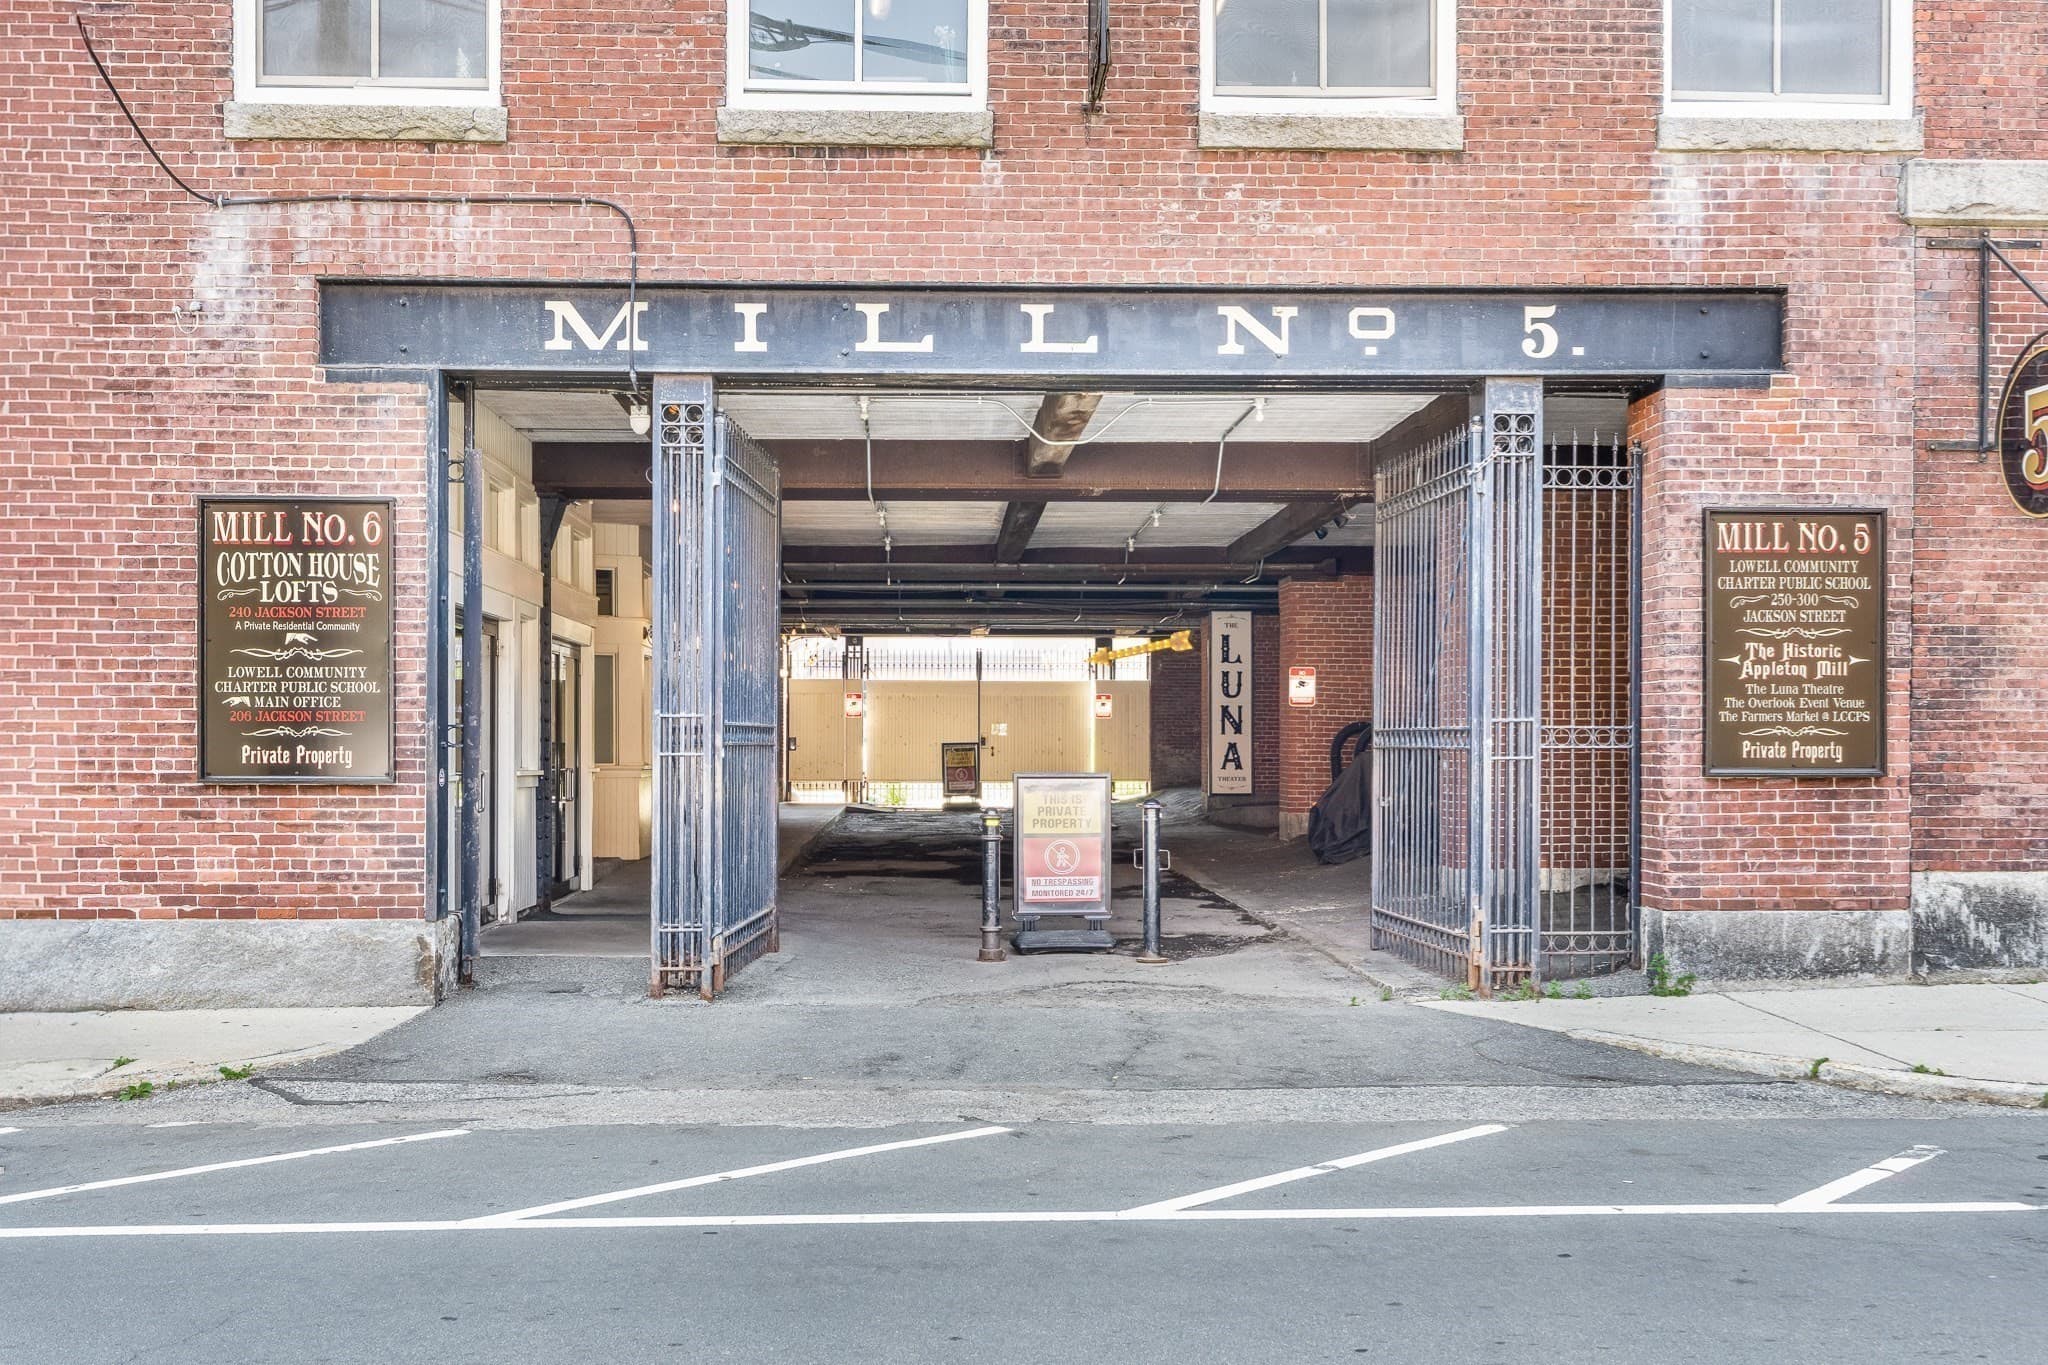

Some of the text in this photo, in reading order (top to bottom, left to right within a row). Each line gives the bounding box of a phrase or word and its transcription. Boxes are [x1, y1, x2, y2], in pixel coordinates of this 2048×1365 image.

[544, 301, 1098, 353] MILL
[212, 511, 383, 546] MILL NO. 6
[1716, 522, 1872, 555] MILL NO. 5
[216, 552, 381, 588] COTTON HOUSE
[1729, 560, 1860, 573] LOWELL COMMUNITY
[1717, 576, 1872, 590] CHARTER PUBLIC SCHOOL
[259, 580, 339, 605] LOFTS
[1770, 593, 1819, 606] 250-300
[228, 606, 367, 618] 240 JACKSON STREET
[1743, 609, 1847, 622] JACKSON STREET
[235, 621, 360, 633] A Private Residential Community
[1744, 642, 1843, 662] The Historic
[227, 666, 368, 679] LOWELL COMMUNITY
[1738, 660, 1849, 680] Appleton Mill
[214, 681, 381, 694] CHARTER PUBLIC SCHOOL
[1745, 683, 1845, 695] The Luna Theatre
[254, 696, 341, 708] MAIN OFFICE
[1220, 634, 1243, 770] LUNA
[1724, 697, 1865, 709] The Overlook Event Venue
[255, 710, 312, 722] JACKSON
[315, 710, 367, 722] STREET
[1719, 711, 1871, 723] The Farmers Market @ LCCPS
[241, 745, 352, 768] Private Property
[1742, 740, 1843, 763] Private Property
[1043, 794, 1068, 805] THIS
[1037, 806, 1087, 816] PRIVATE
[1032, 818, 1093, 829] PROPERTY
[1031, 878, 1094, 886] NO TRESPASSING
[1031, 889, 1094, 897] MONITORED 24/7
